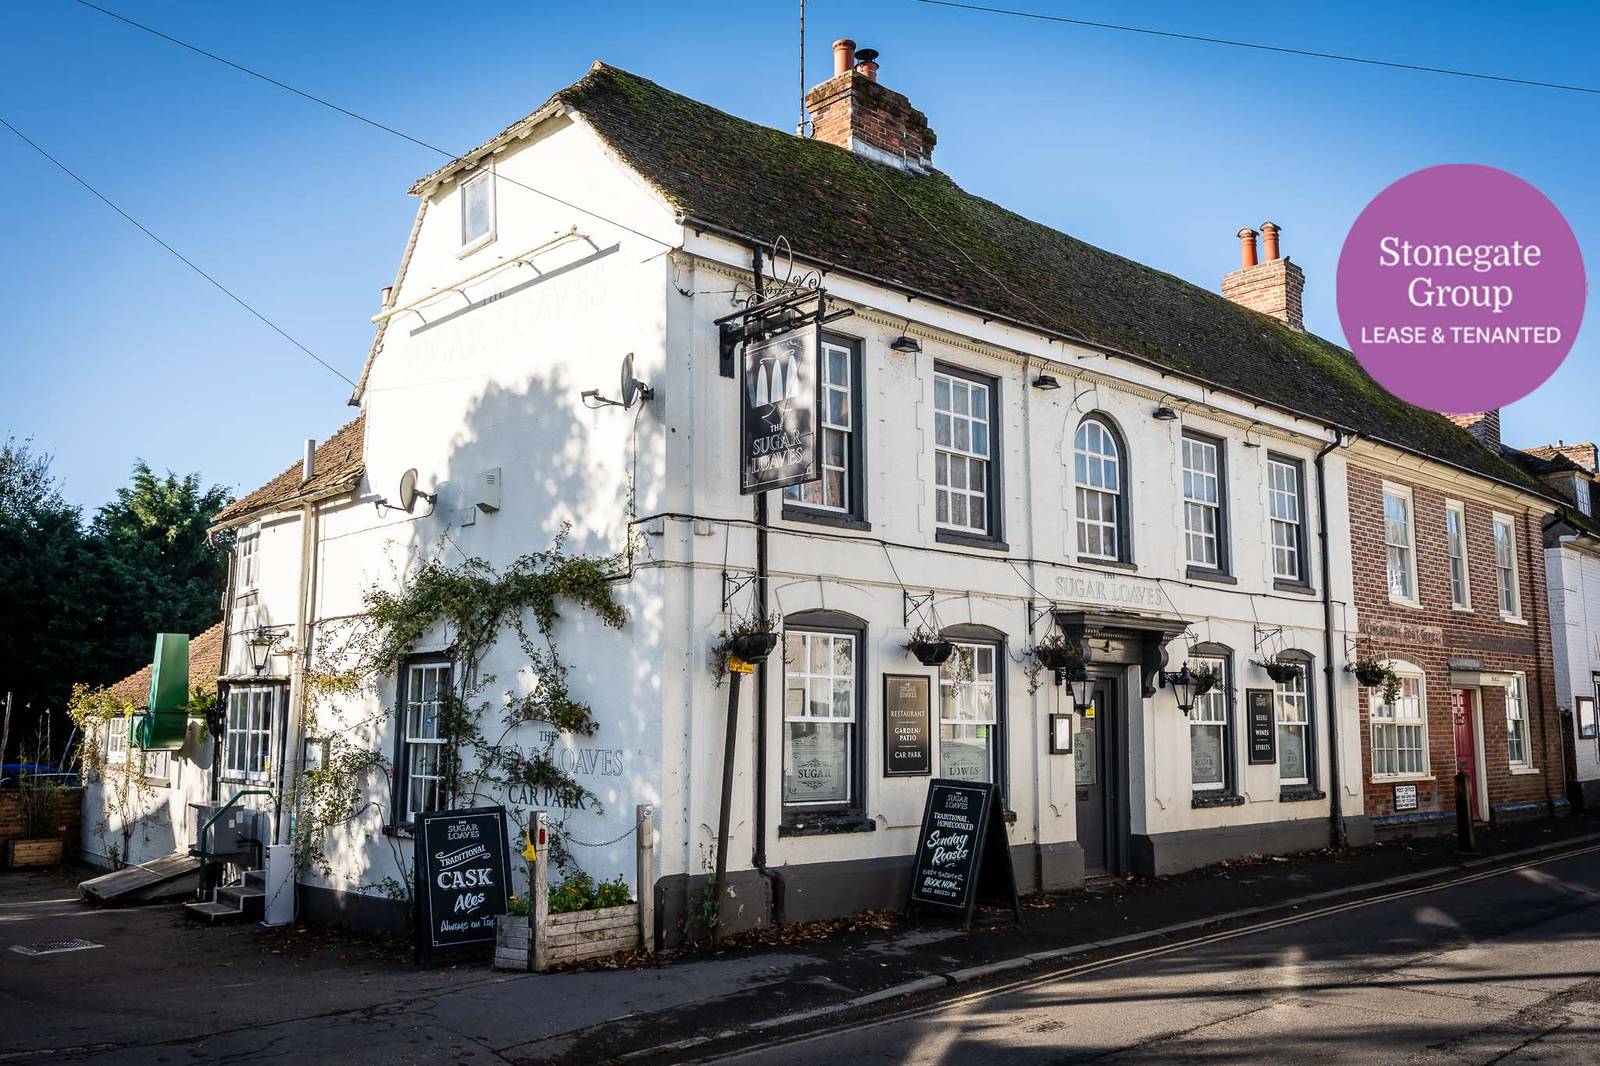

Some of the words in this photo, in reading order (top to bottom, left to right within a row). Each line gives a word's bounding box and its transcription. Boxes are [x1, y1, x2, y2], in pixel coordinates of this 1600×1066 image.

[752, 428, 802, 456] SUGAR
[751, 446, 803, 474] LOAVES
[1055, 575, 1107, 600] SUGAR
[1112, 583, 1162, 606] LOAVES
[890, 710, 925, 718] RESTAURANT
[539, 730, 557, 742] THE
[894, 727, 921, 735] GARDEN/
[899, 734, 917, 742] PATIO
[894, 751, 907, 759] CAR
[908, 751, 922, 759] PARK
[547, 746, 624, 777] LOAVES
[798, 768, 831, 779] SUGAR
[508, 784, 539, 807] CAR
[543, 786, 586, 810] PARK
[947, 794, 968, 803] SUGAR
[945, 801, 969, 810] LOAVES
[448, 823, 479, 834] SUGAR
[937, 820, 974, 831] HOMECOOKED
[448, 830, 480, 841] LOAVES
[927, 829, 969, 850] Sunday
[440, 844, 487, 867] TRADITIONAL
[931, 846, 968, 865] Roasts
[437, 868, 494, 889] CASK
[924, 876, 942, 888] BOOK
[454, 892, 486, 913] Ales
[440, 919, 469, 933] Always
